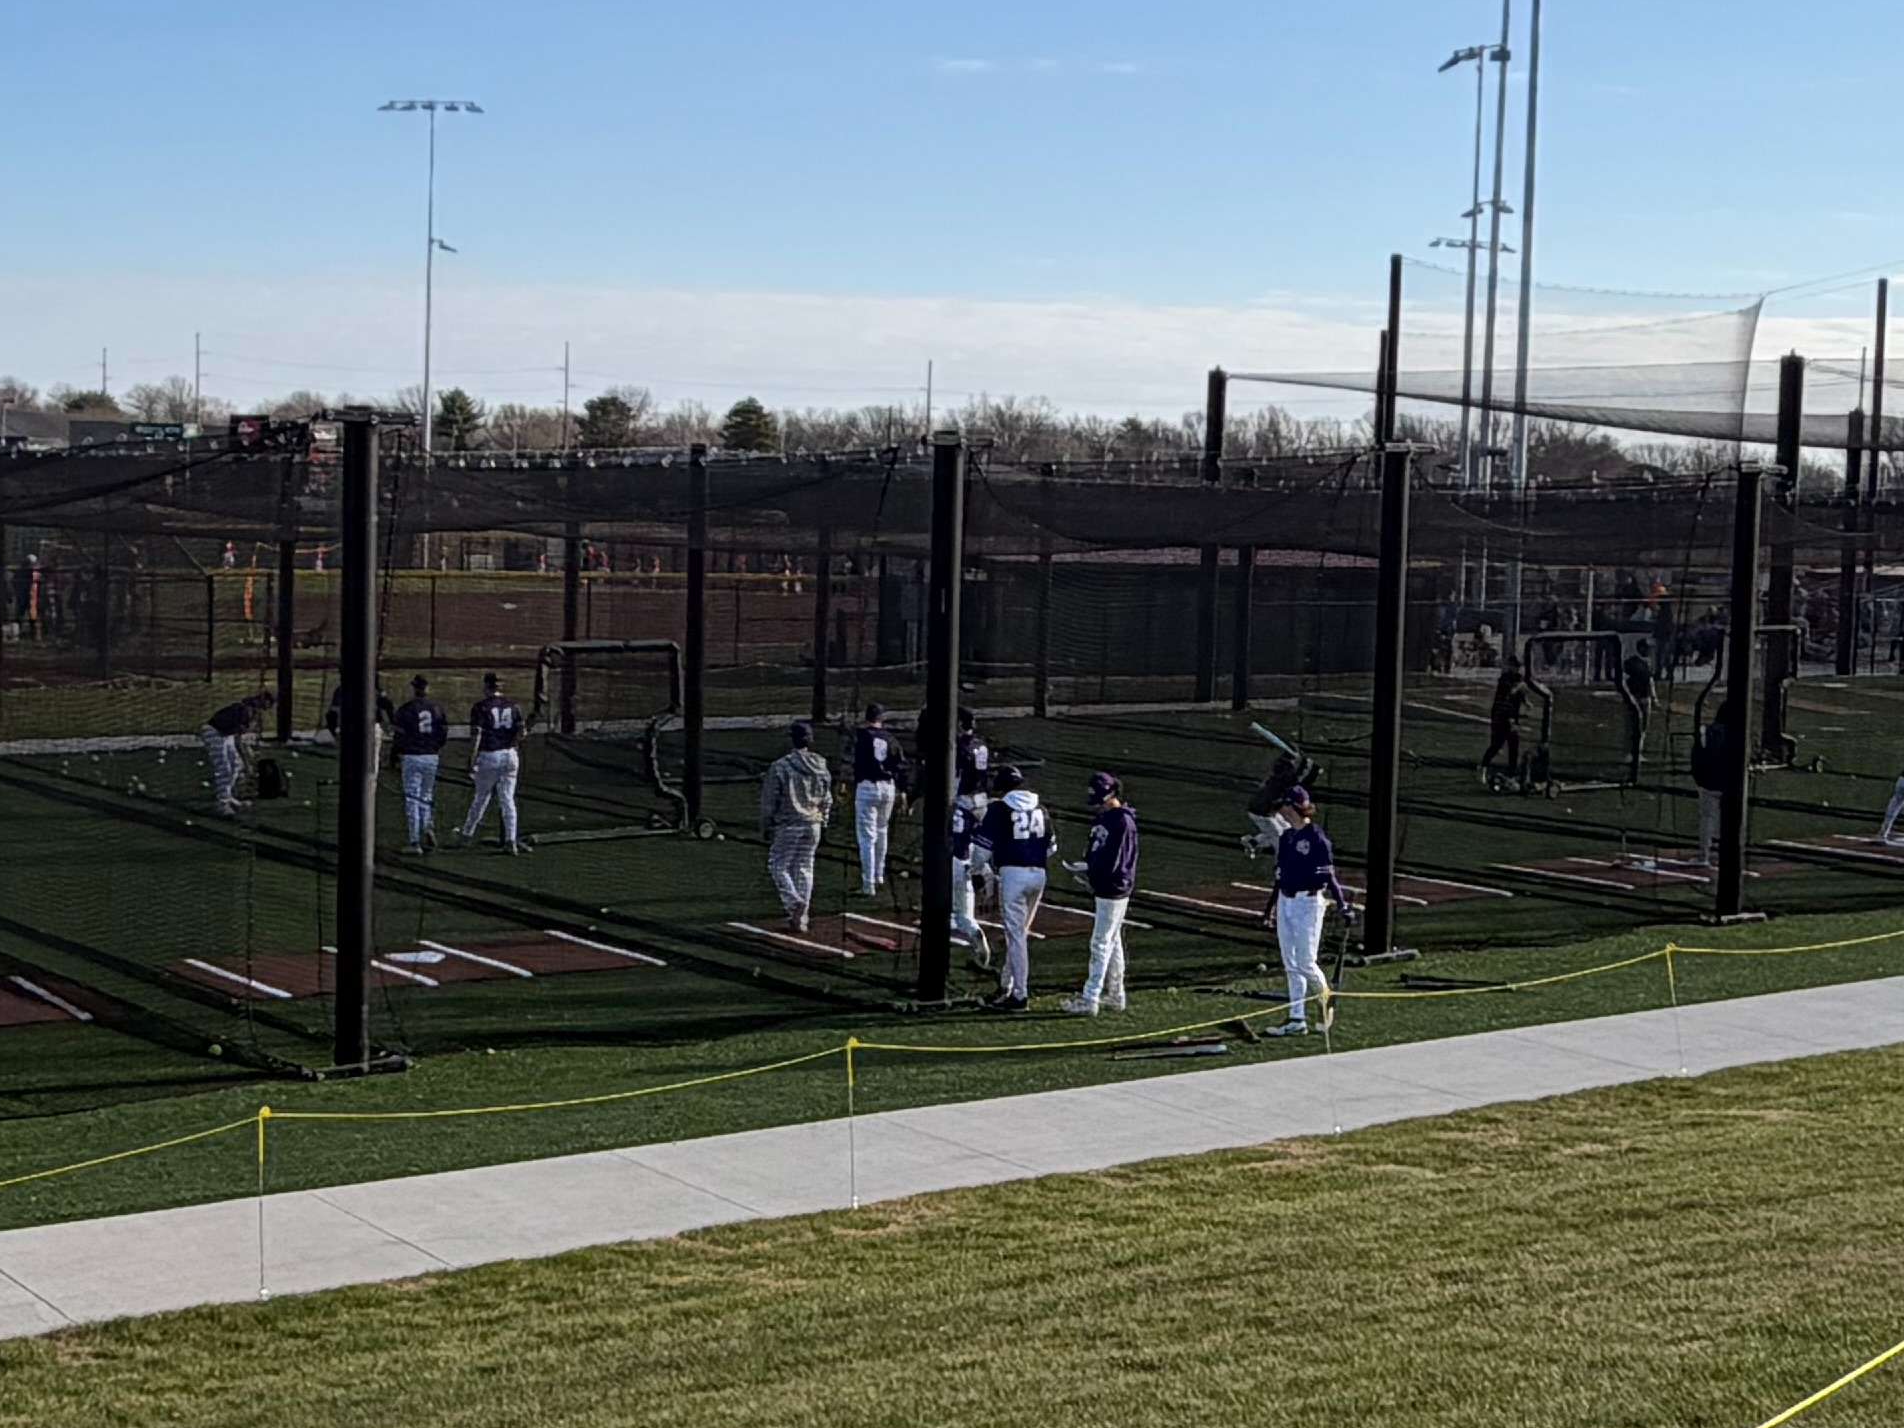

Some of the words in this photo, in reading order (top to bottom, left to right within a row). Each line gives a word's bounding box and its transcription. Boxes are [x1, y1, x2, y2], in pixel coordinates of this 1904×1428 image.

[418, 710, 432, 733] 2
[491, 707, 512, 729] 14
[1011, 809, 1045, 839] 24
